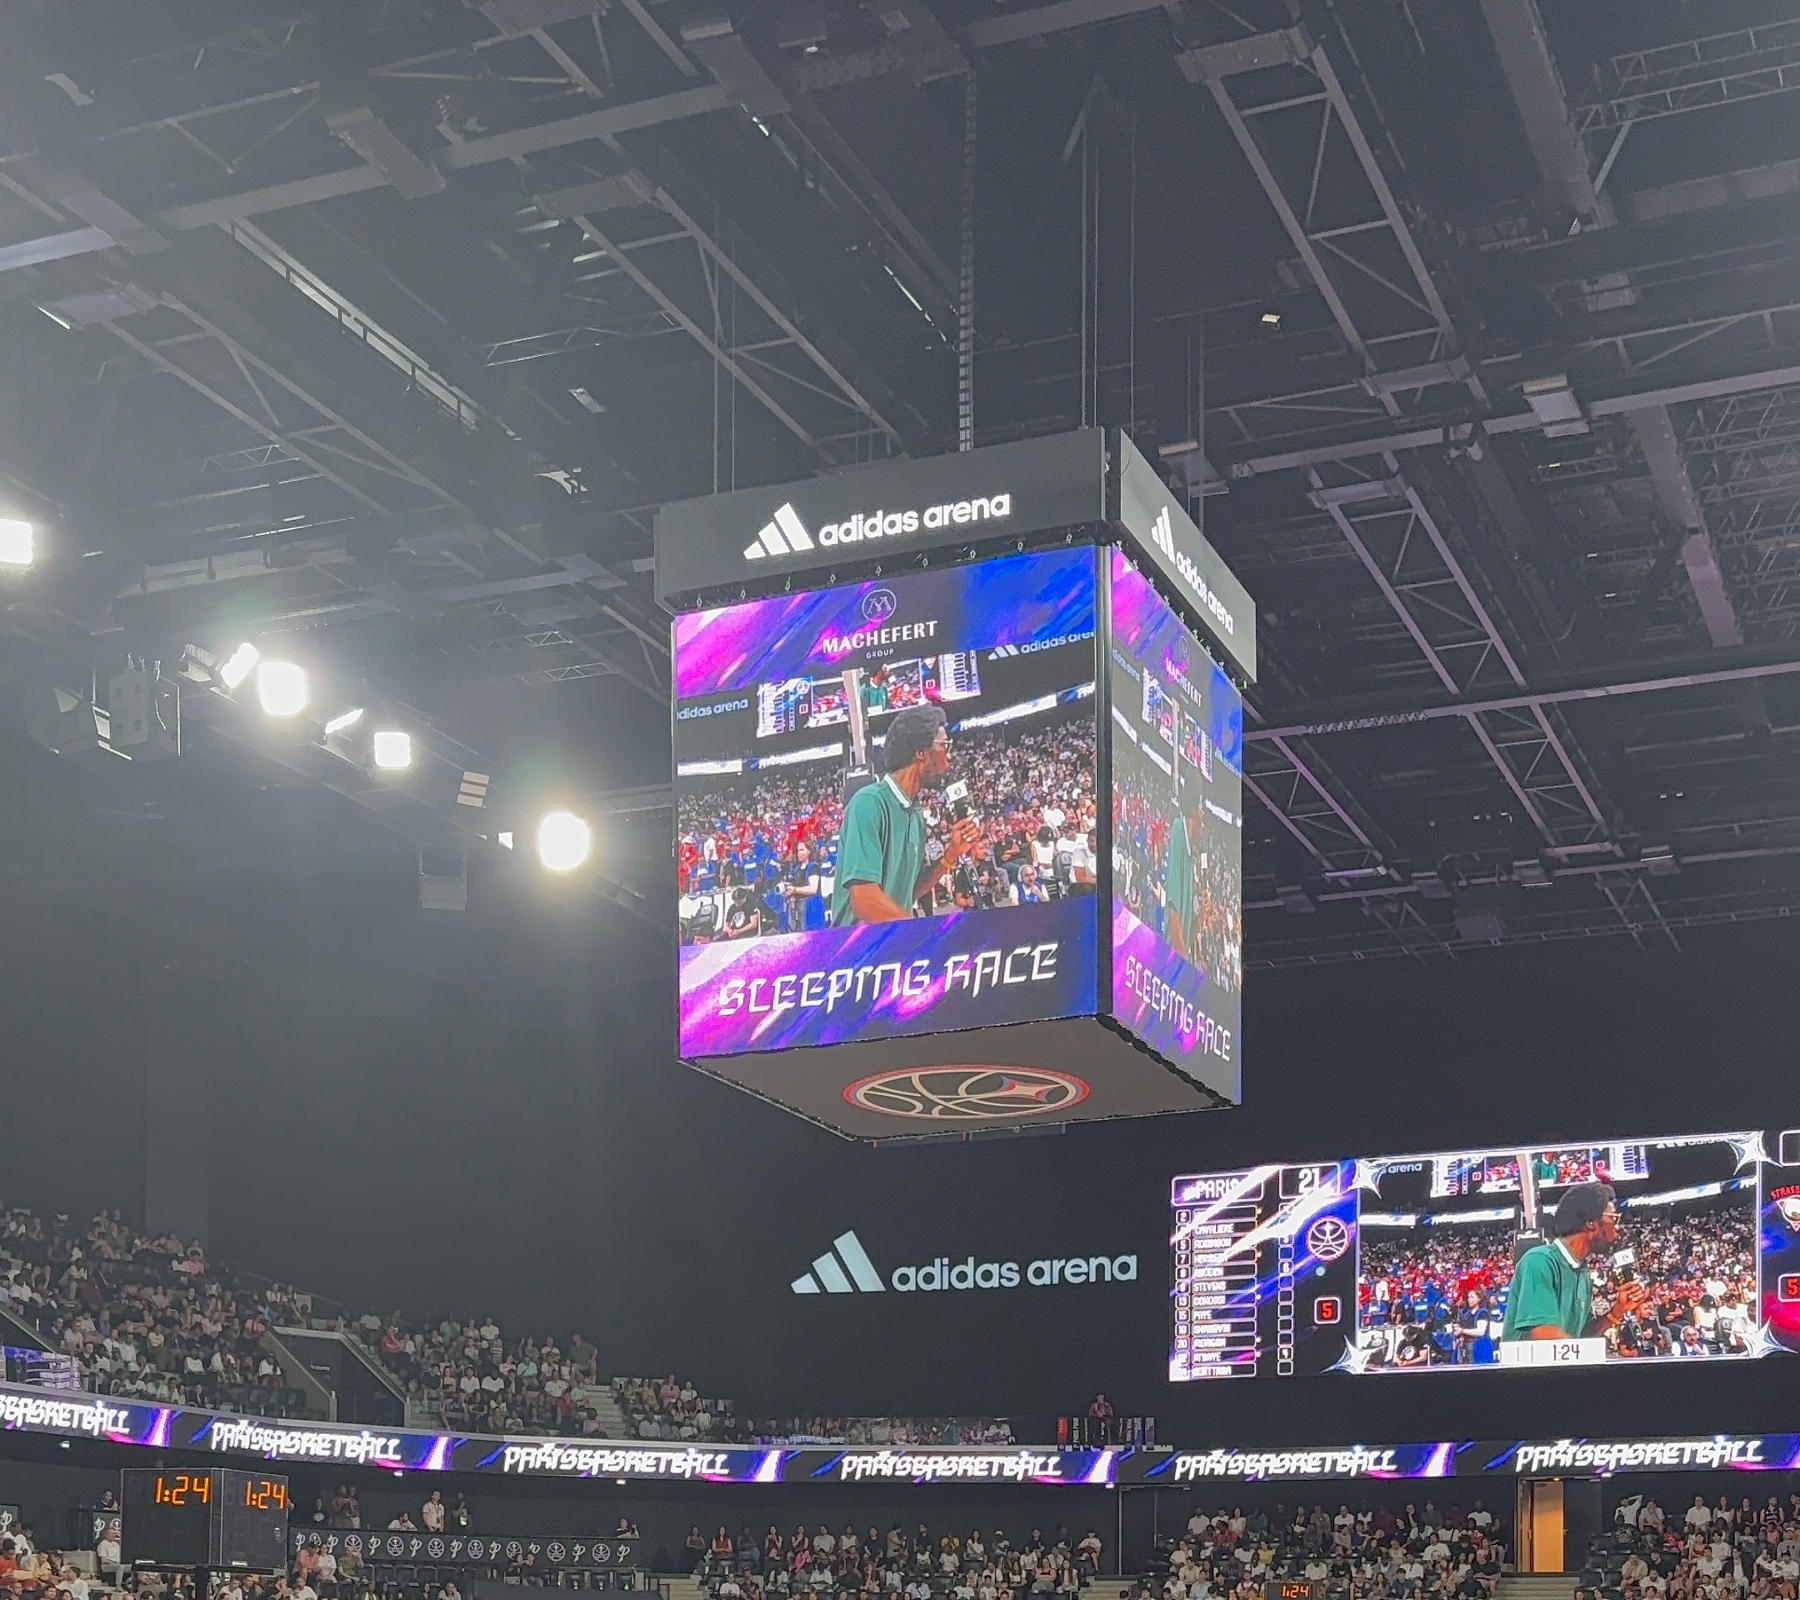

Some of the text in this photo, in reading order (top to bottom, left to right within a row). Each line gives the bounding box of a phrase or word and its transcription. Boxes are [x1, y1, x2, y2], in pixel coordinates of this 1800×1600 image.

[818, 493, 1011, 547] adidas arena
[1175, 550, 1235, 636] adidas arena
[821, 620, 938, 659] MACHEFERT GROUP
[1021, 635, 1066, 654] adidas
[714, 699, 748, 715] arena
[717, 942, 1059, 1017] SLEEPING RACE
[1126, 955, 1231, 1062] SLEEPING RACE
[1298, 1167, 1320, 1193] 21
[1388, 1162, 1423, 1174] arena
[892, 1253, 1137, 1292] adidas arena
[1786, 1278, 1799, 1296] 5
[1321, 1302, 1334, 1319] 5
[154, 1476, 209, 1505] 1:24
[245, 1481, 286, 1508] 1:24
[1282, 1584, 1309, 1599] 1:24
